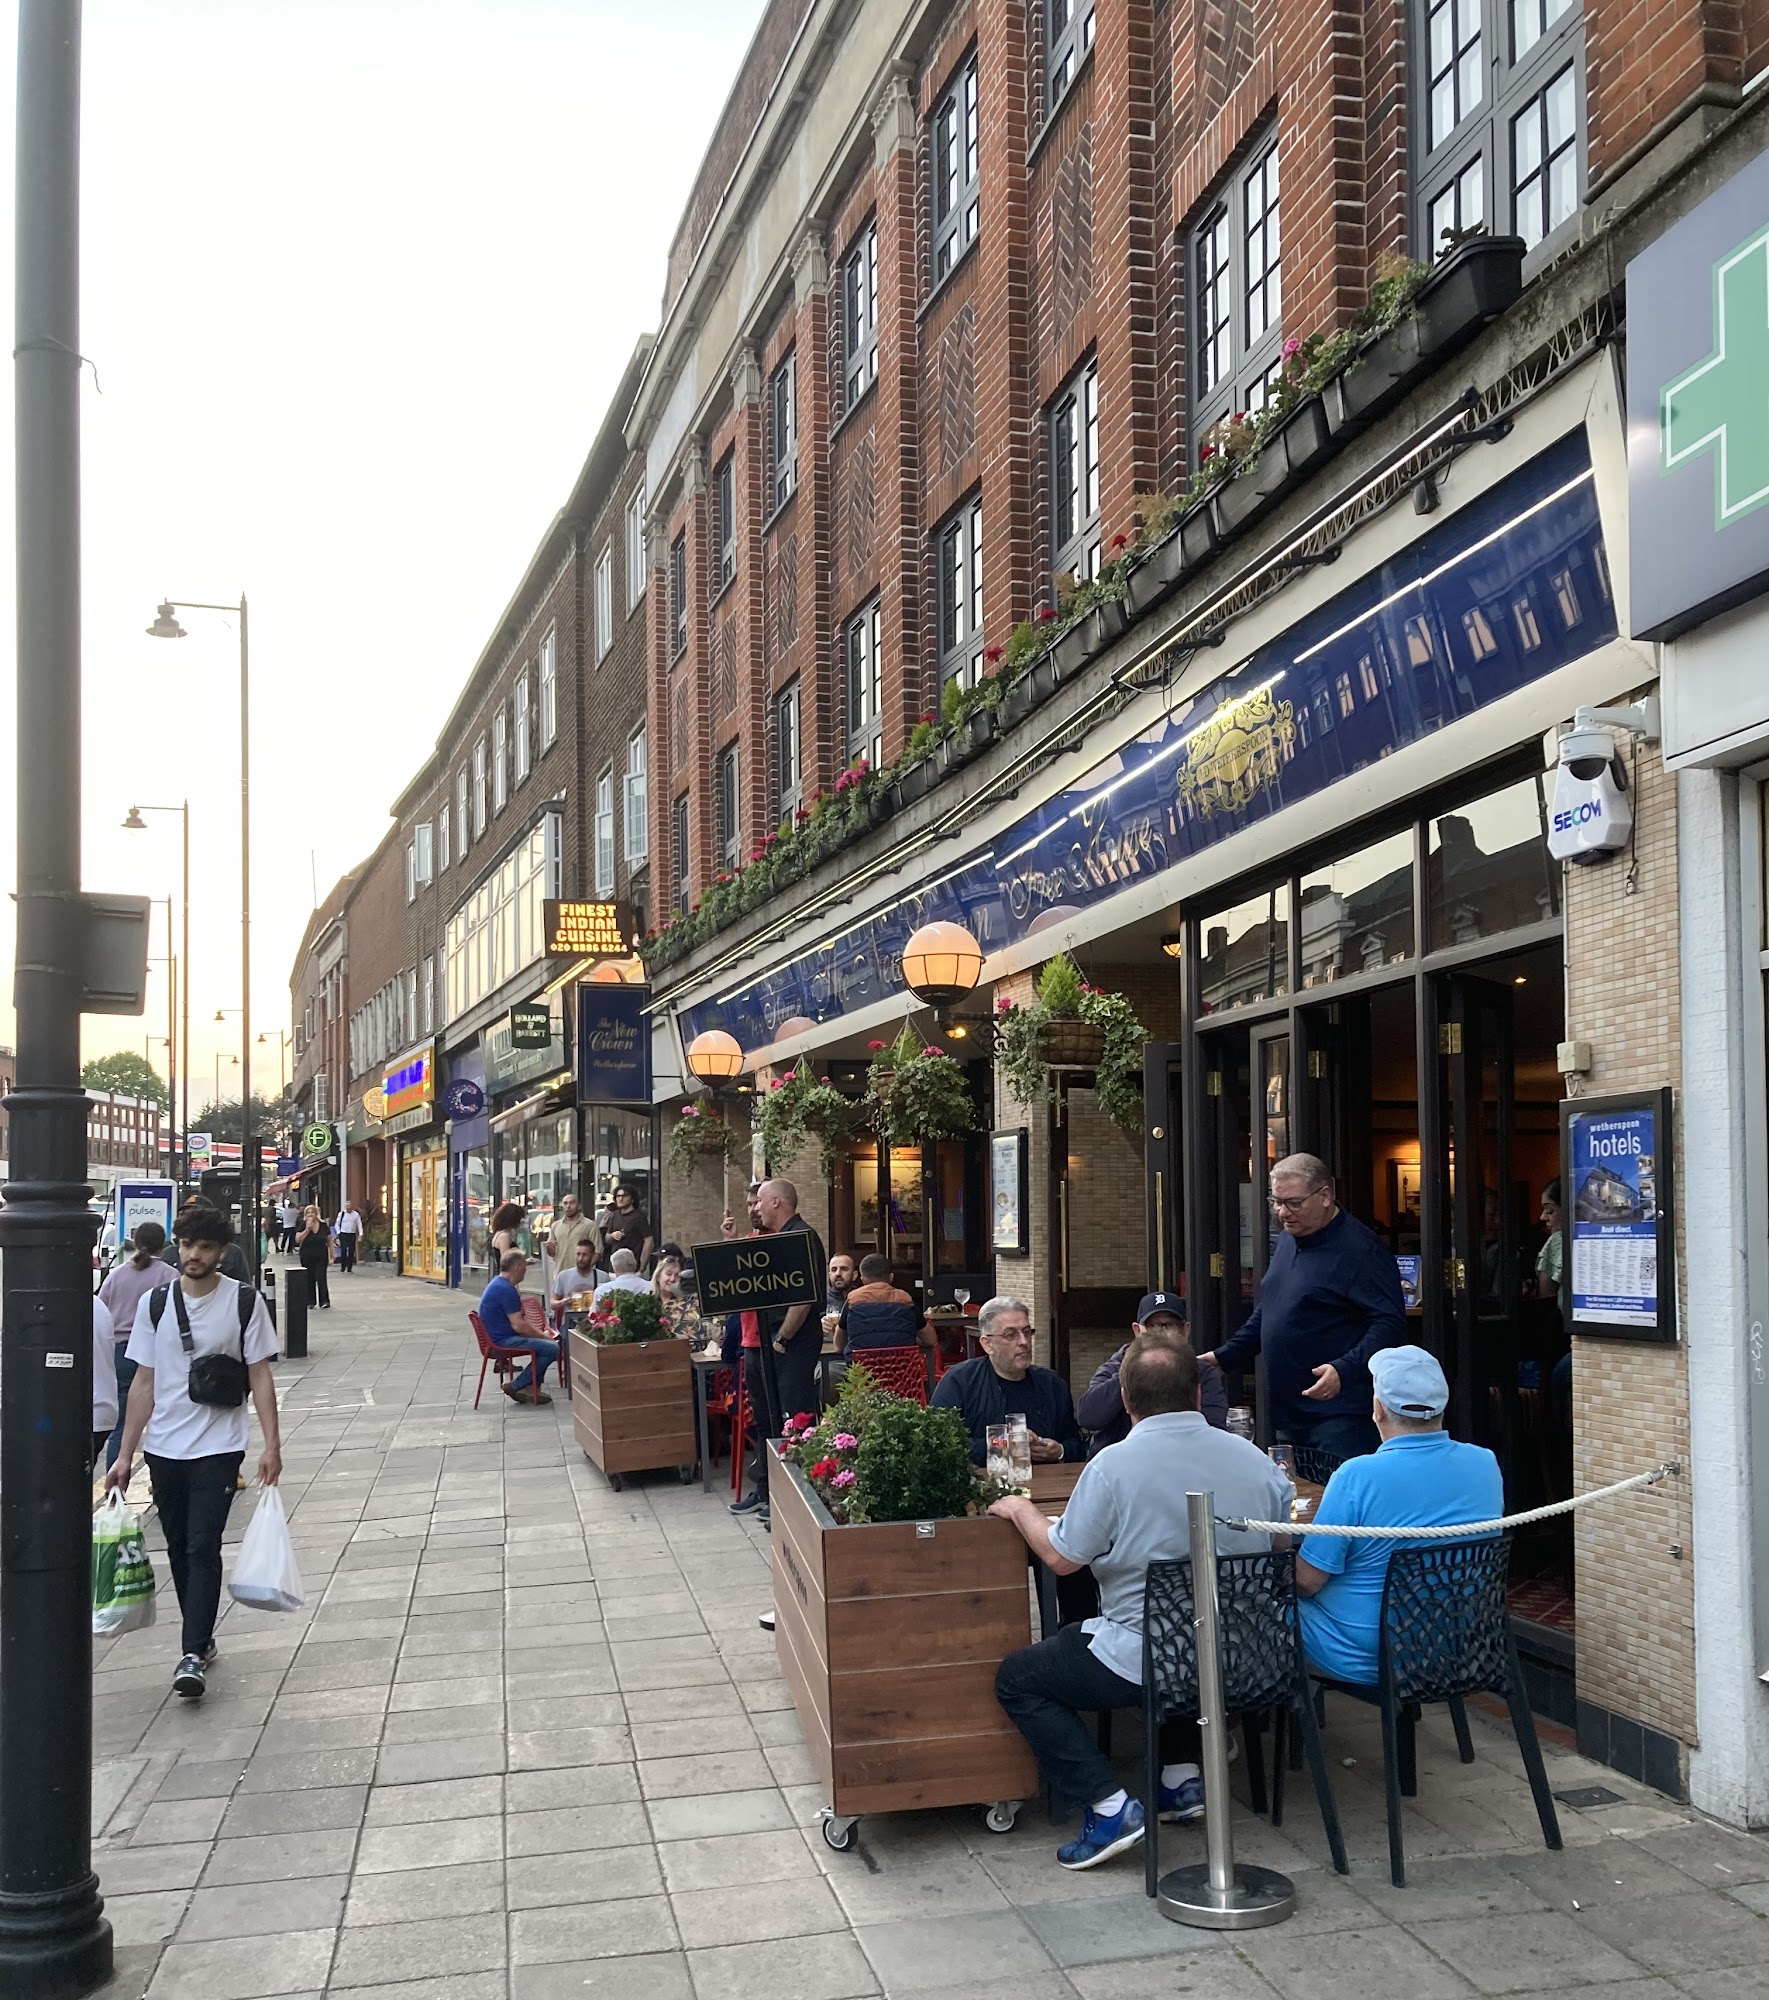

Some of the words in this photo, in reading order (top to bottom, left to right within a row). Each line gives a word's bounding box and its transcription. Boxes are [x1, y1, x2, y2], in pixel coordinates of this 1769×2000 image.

[1553, 798, 1602, 833] SECOM
[559, 904, 617, 917] FINEST
[560, 917, 617, 930] INDIAN
[556, 930, 622, 943] CUISINE
[550, 943, 571, 952] 020
[605, 1018, 639, 1039] New
[589, 1030, 634, 1051] Crown
[1590, 1120, 1640, 1132] wetherspoon
[1590, 1131, 1642, 1158] hotels
[129, 1206, 155, 1216] pulse
[736, 1251, 770, 1270] NO
[708, 1270, 805, 1298] SMOKING
